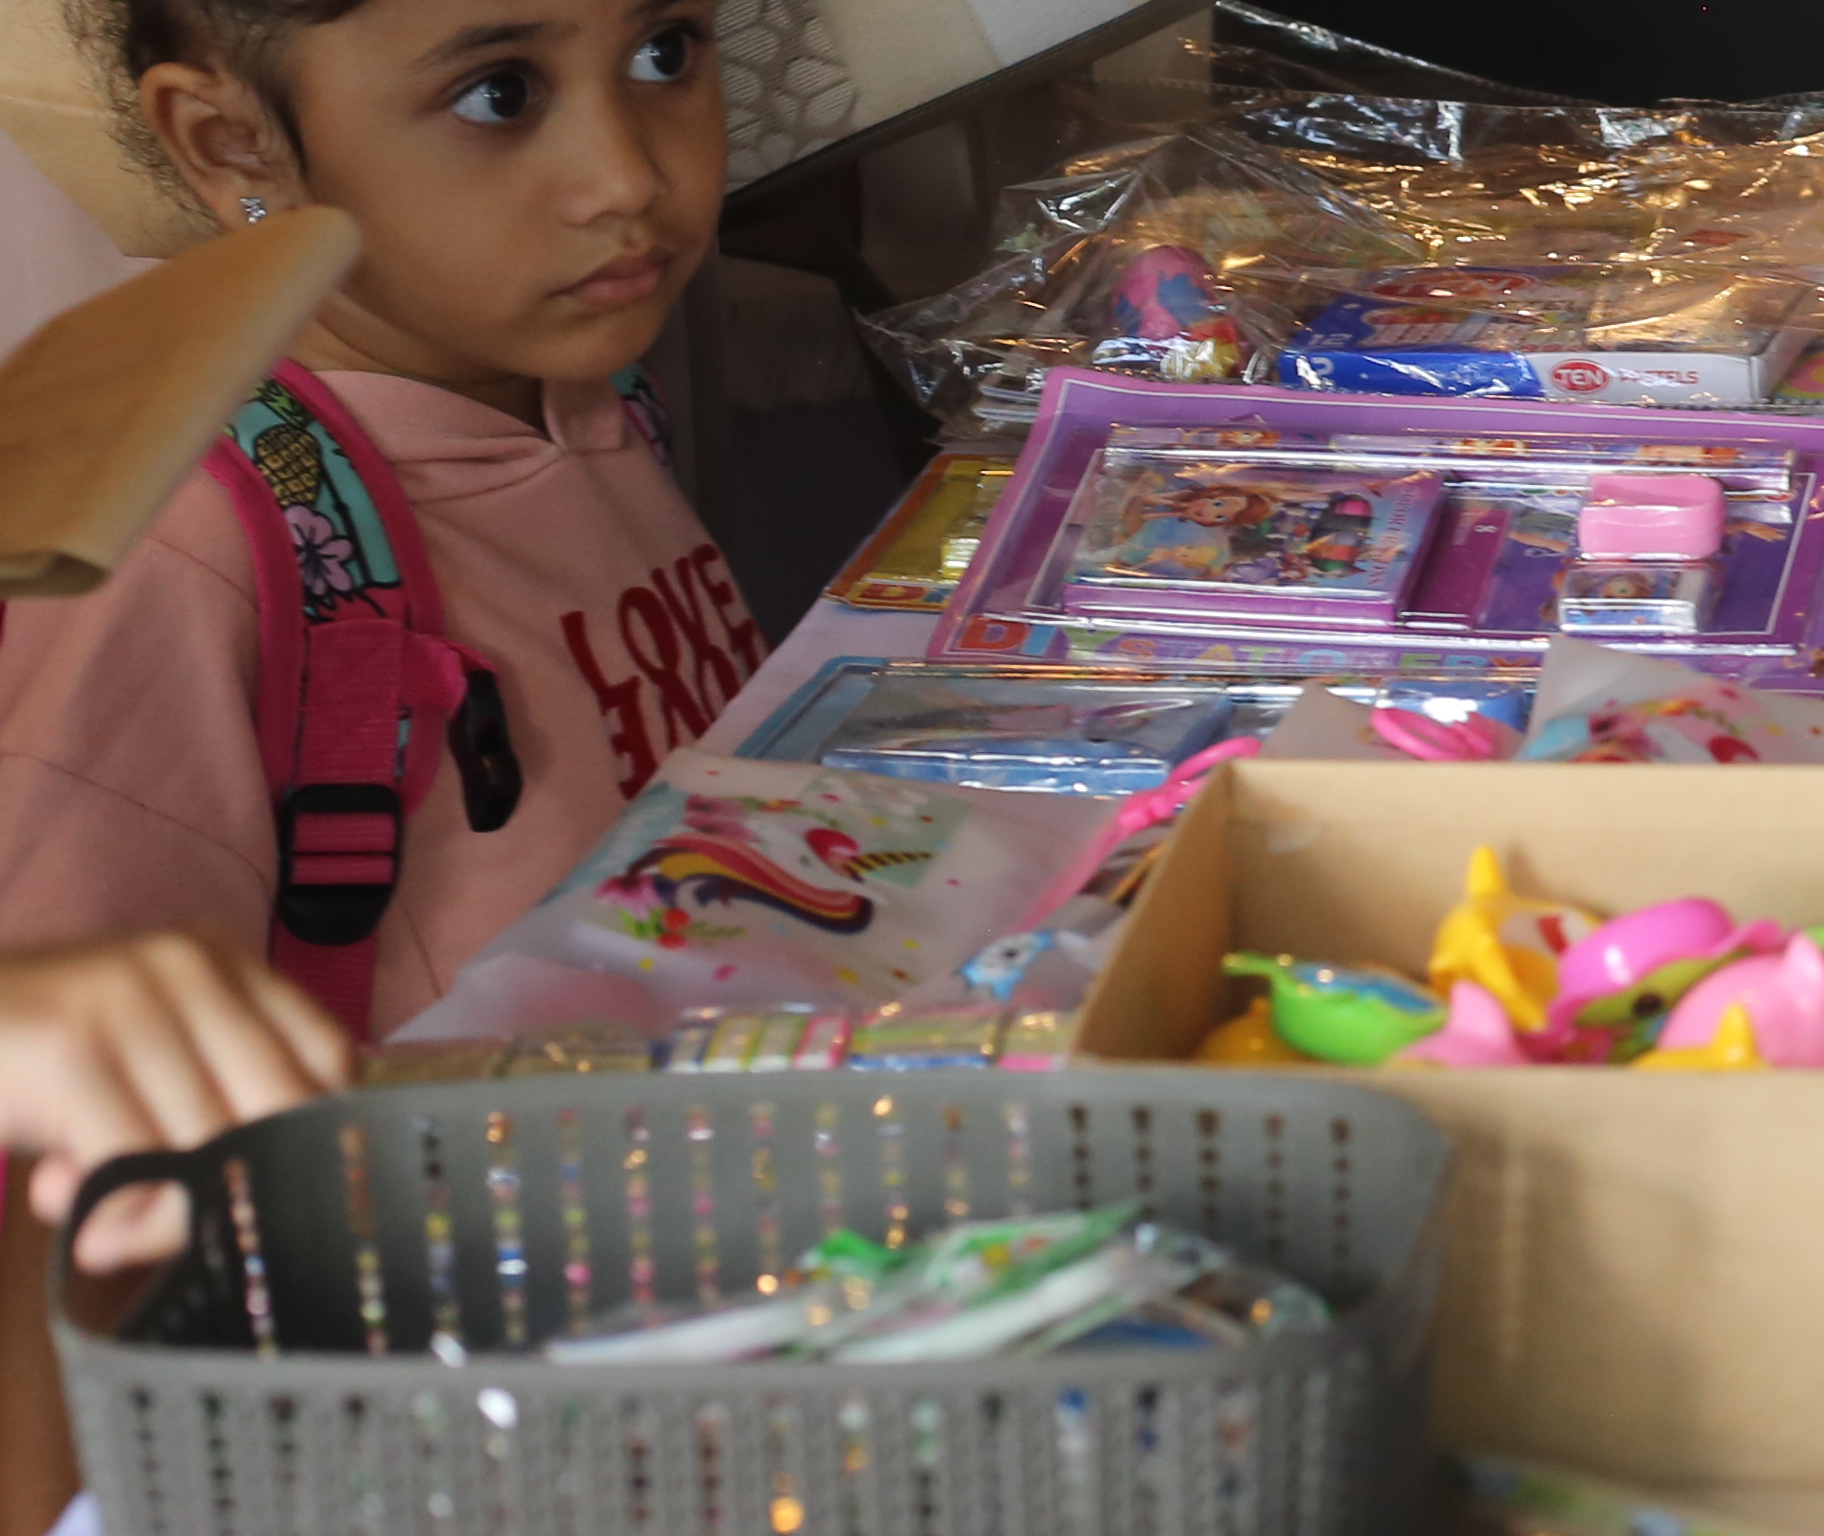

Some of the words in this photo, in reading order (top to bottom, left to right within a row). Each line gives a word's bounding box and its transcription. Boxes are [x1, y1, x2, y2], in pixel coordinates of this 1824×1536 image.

[1556, 368, 1603, 387] TEN
[858, 582, 953, 603] DI
[559, 542, 735, 709] LOVE
[957, 613, 1122, 661] DIY
